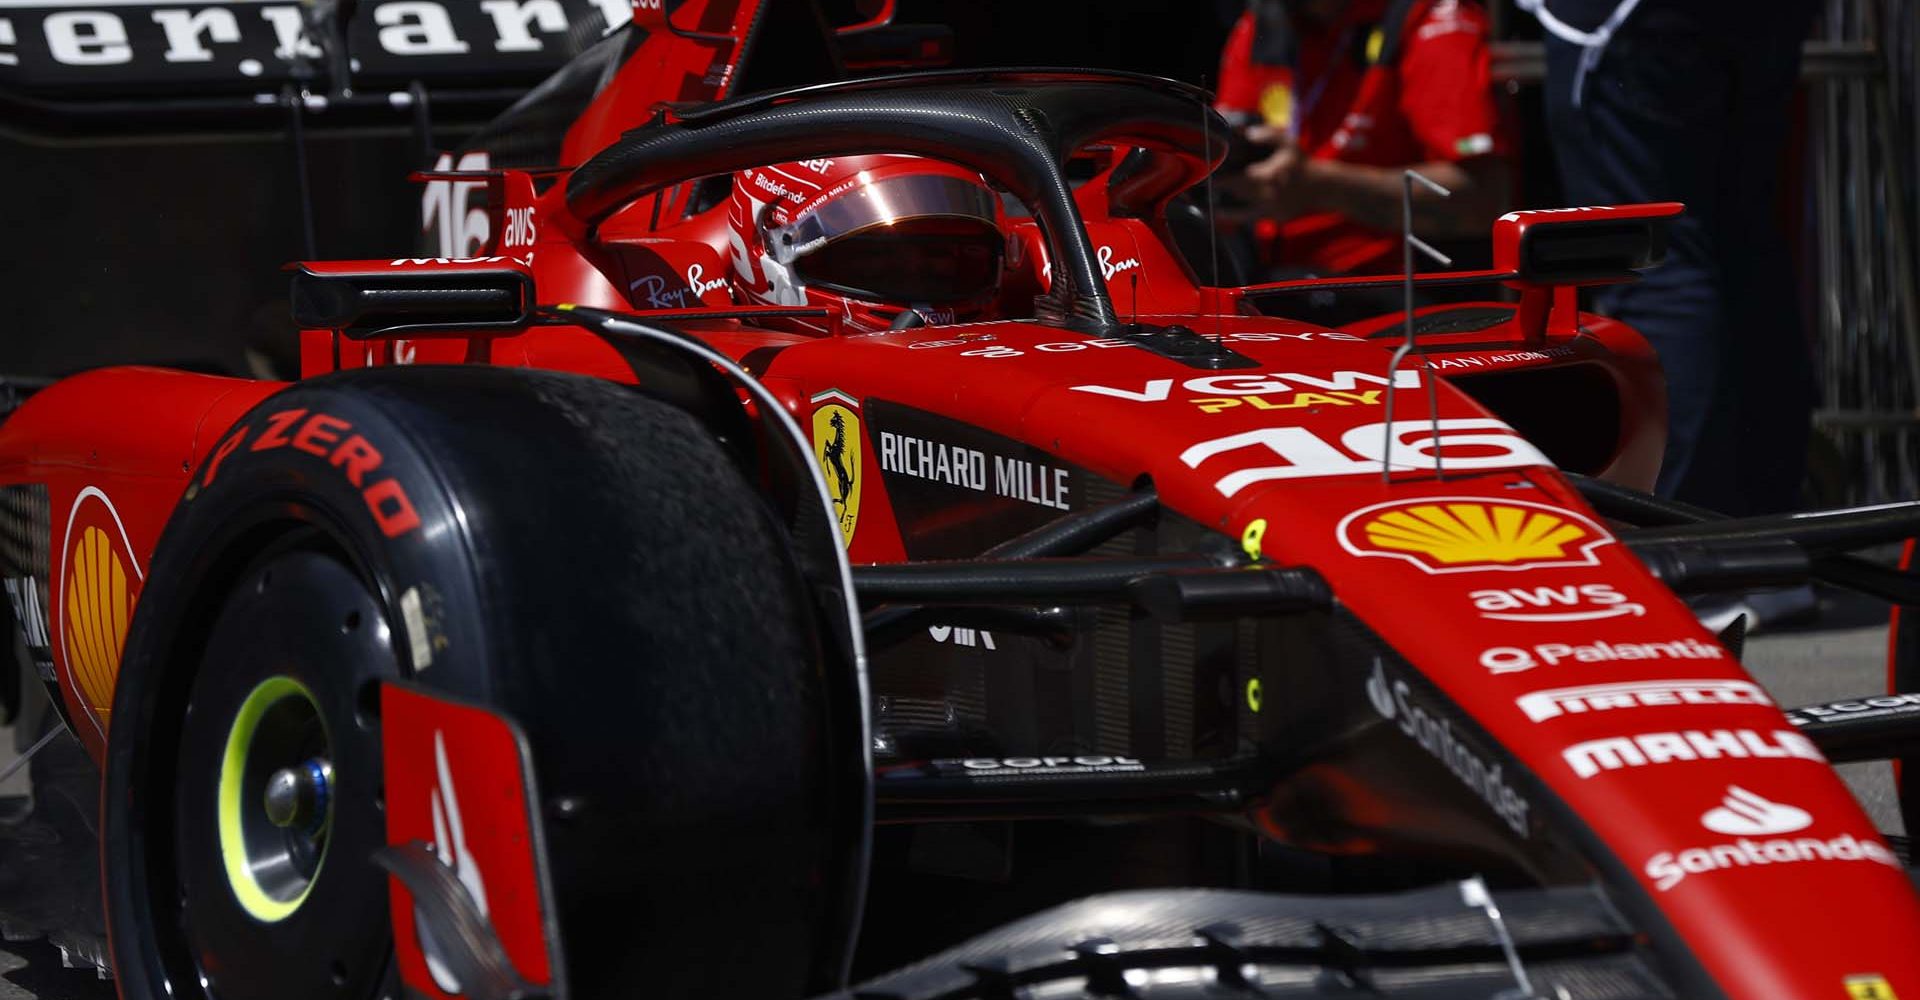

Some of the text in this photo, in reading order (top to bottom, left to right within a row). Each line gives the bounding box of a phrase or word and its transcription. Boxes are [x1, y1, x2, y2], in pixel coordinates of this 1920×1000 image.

[422, 152, 490, 259] 16
[504, 207, 536, 247] aws
[630, 263, 728, 309] Ray-Ban
[1069, 370, 1422, 403] VGW
[1188, 390, 1383, 414] PLAY
[202, 408, 421, 540] P ZERO
[880, 431, 1070, 511] RICHARD MILLE
[1178, 418, 1554, 499] 16
[1468, 584, 1628, 611] aws
